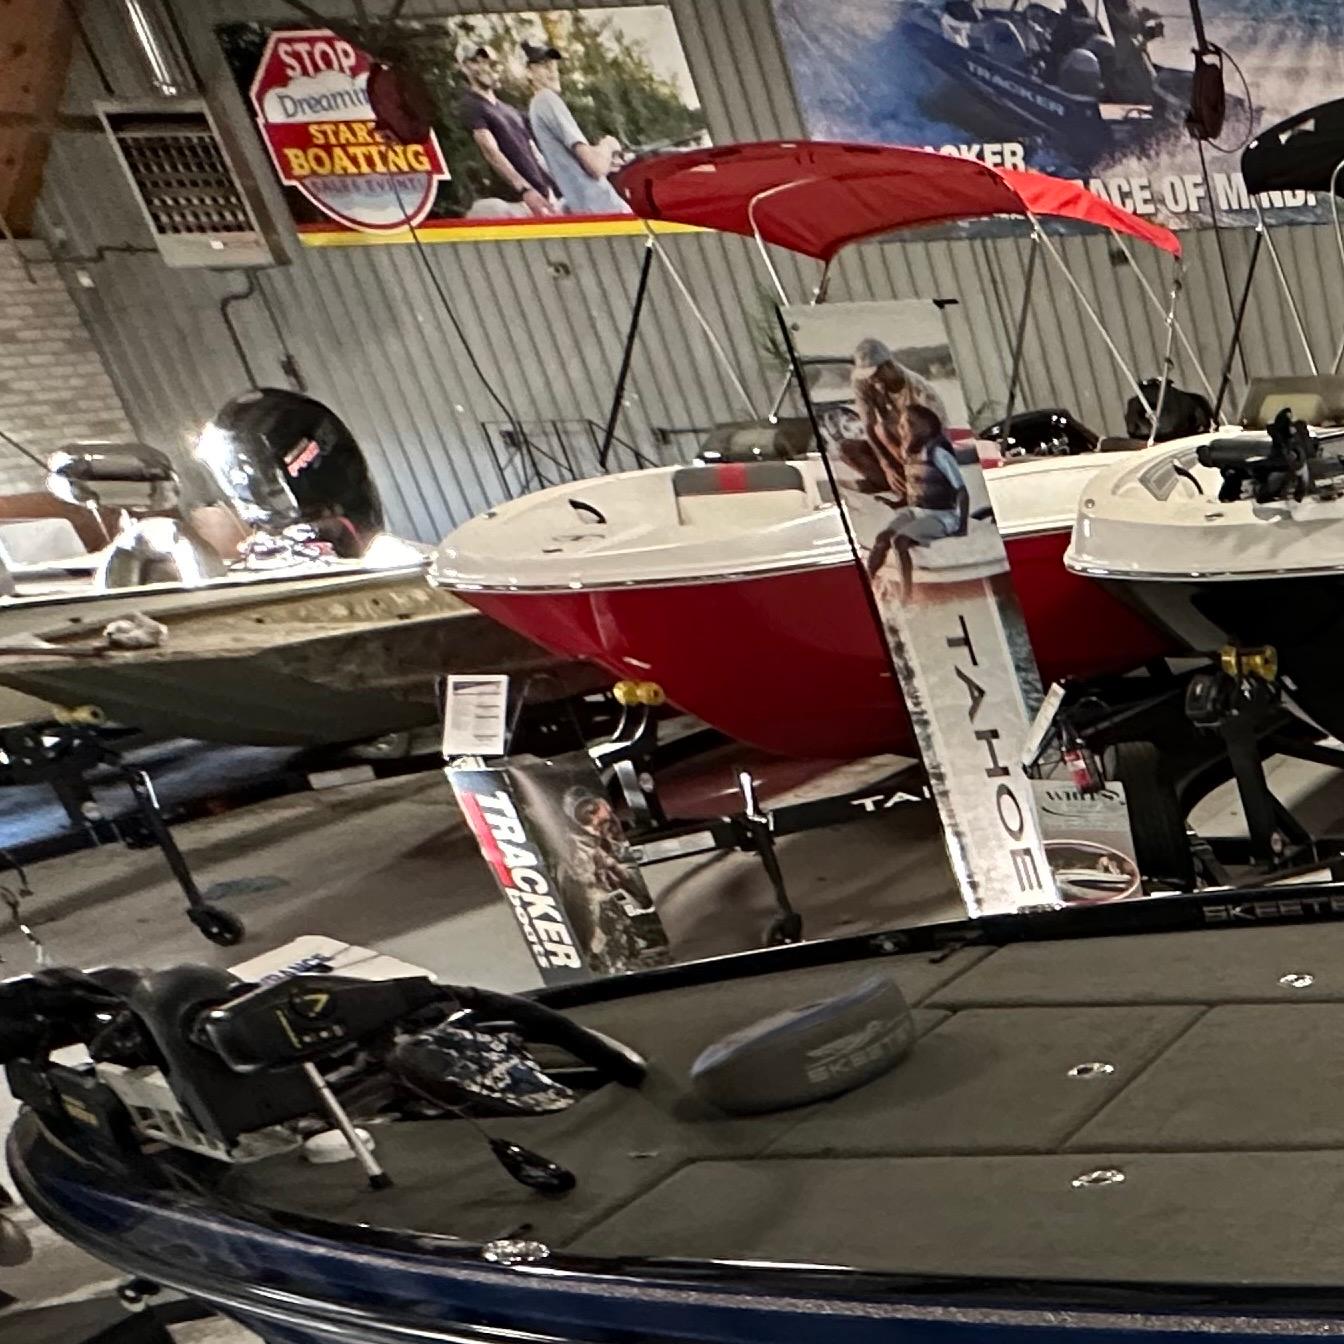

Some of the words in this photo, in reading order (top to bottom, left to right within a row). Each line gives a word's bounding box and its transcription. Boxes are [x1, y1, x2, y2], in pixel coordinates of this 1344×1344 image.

[277, 40, 357, 78] STOP
[284, 147, 432, 175] BOATING
[1163, 173, 1206, 214] OF
[946, 614, 1044, 892] TAHOE
[850, 785, 932, 812] TA
[472, 789, 582, 970] TRACKER
